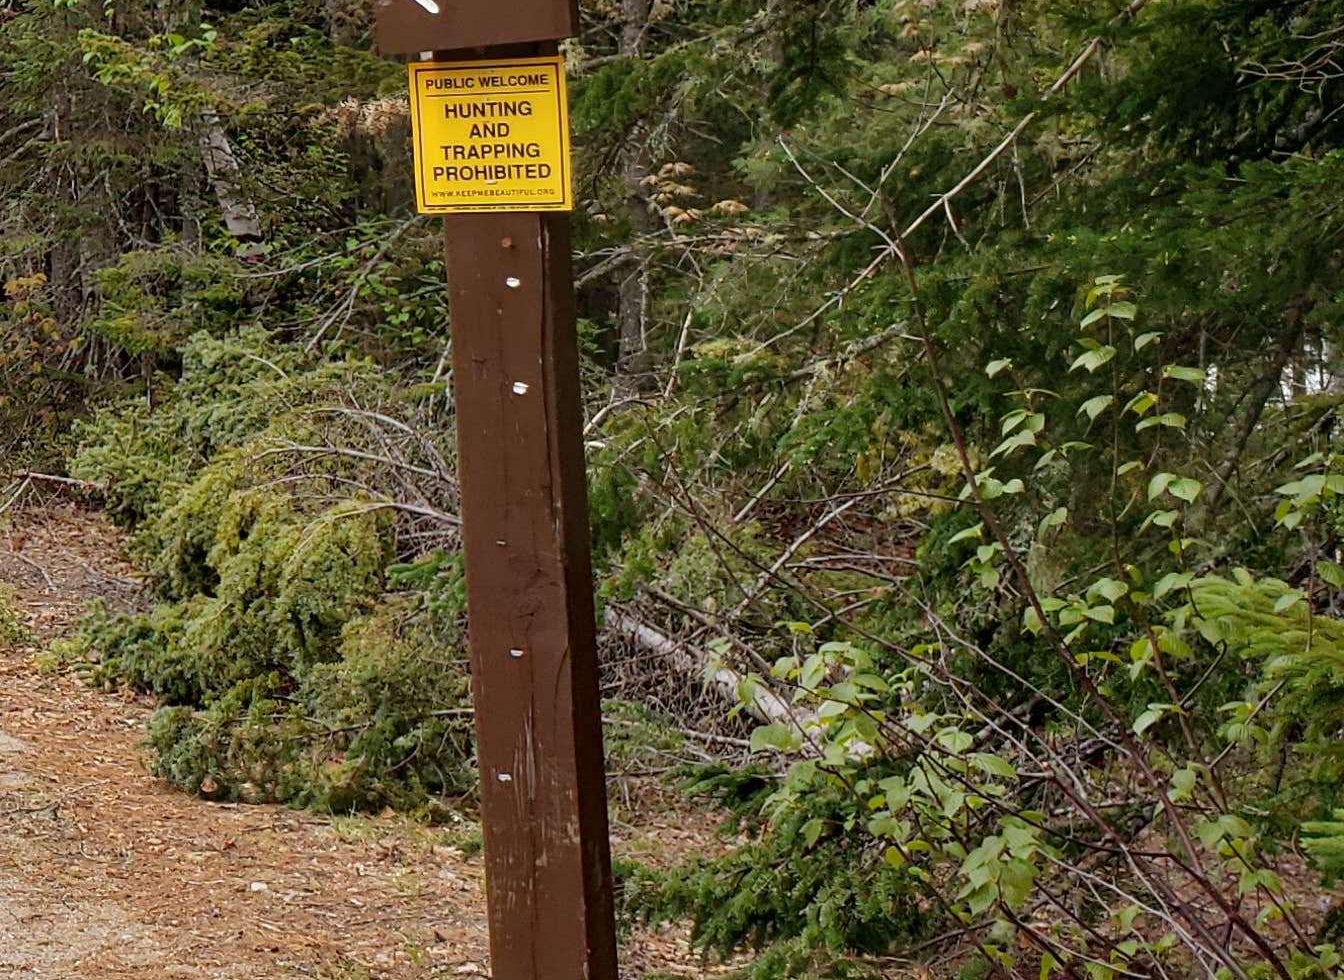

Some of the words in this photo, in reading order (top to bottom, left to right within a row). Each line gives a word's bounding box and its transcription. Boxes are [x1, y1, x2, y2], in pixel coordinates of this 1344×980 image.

[426, 77, 475, 90] PUBLIC
[478, 74, 549, 87] WELCOME
[445, 101, 532, 119] HUNTING
[469, 123, 510, 138] AND
[441, 143, 540, 160] TRAPPING
[433, 164, 551, 181] PROHIBITED
